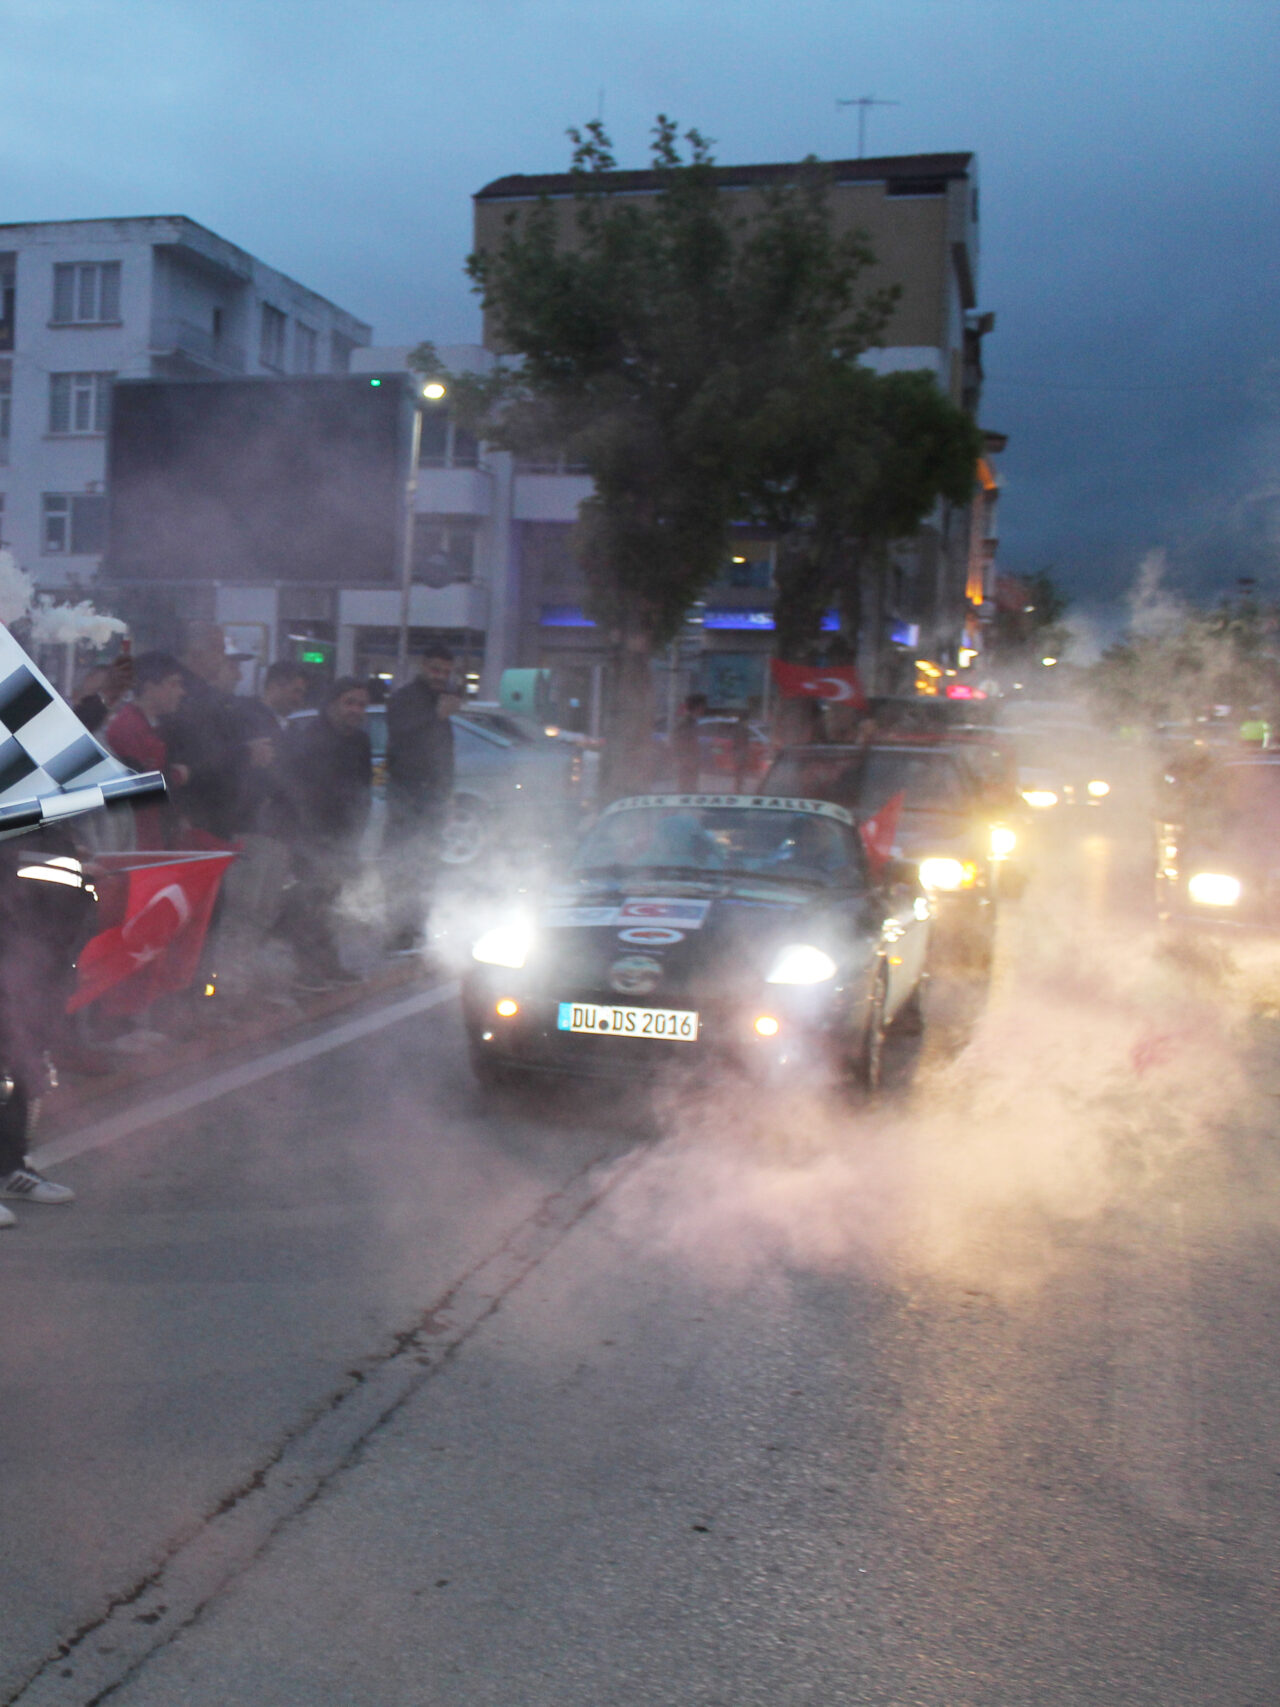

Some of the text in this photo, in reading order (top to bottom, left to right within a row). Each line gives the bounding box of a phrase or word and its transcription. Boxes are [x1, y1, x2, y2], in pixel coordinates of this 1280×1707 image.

[681, 796, 737, 805] ROAD
[752, 798, 825, 811] RALLY
[572, 1007, 596, 1029] DU
[612, 1009, 637, 1032] DS
[642, 1012, 691, 1036] 2016
